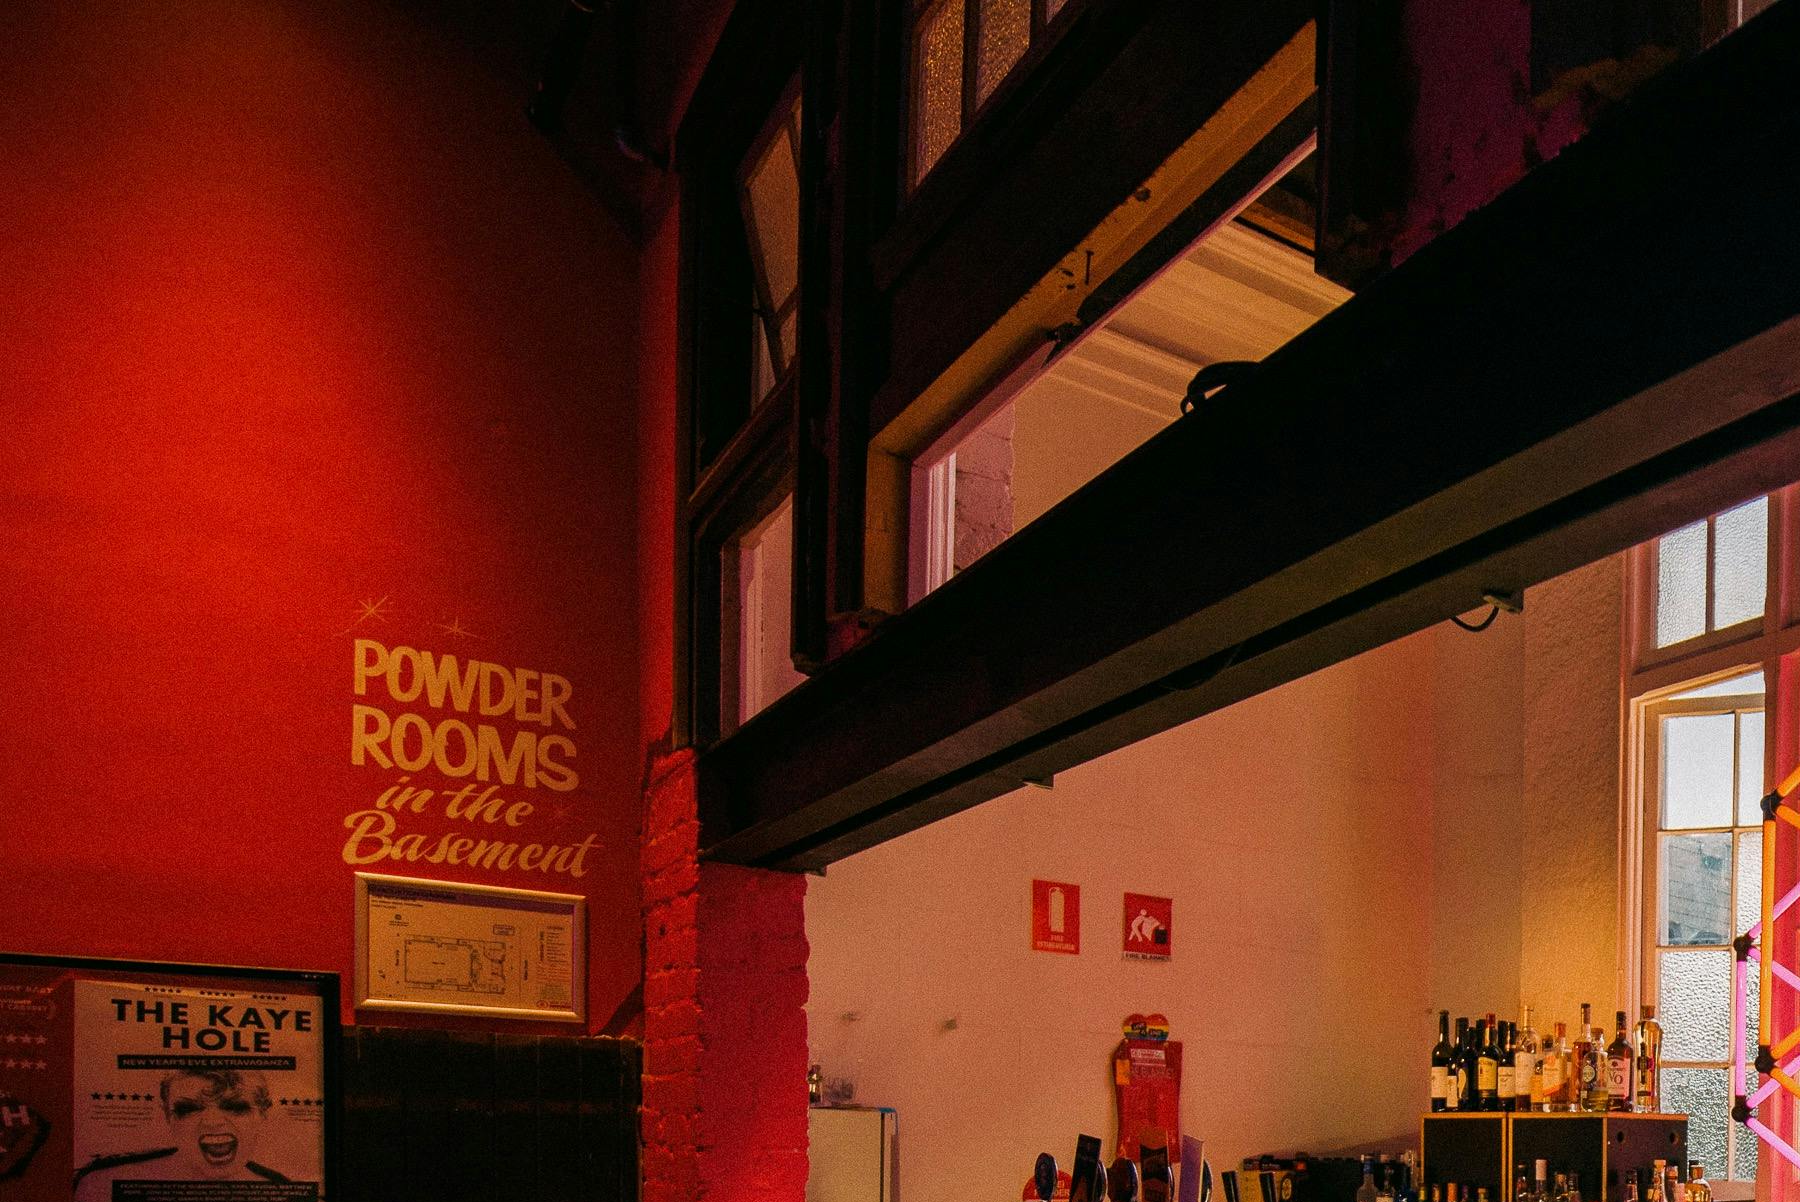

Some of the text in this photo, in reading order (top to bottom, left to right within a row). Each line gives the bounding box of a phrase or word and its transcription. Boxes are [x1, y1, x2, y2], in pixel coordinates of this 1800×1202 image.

[354, 638, 577, 730] POWDER
[352, 704, 579, 792] ROOMS
[376, 776, 534, 827] in the
[342, 809, 605, 878] Basement
[111, 999, 311, 1032] THE KAYE
[163, 1027, 270, 1053] HOLE
[122, 1058, 146, 1067] NEW
[188, 1058, 207, 1067] EVE
[210, 1058, 290, 1067] EXTRAVAGANZA
